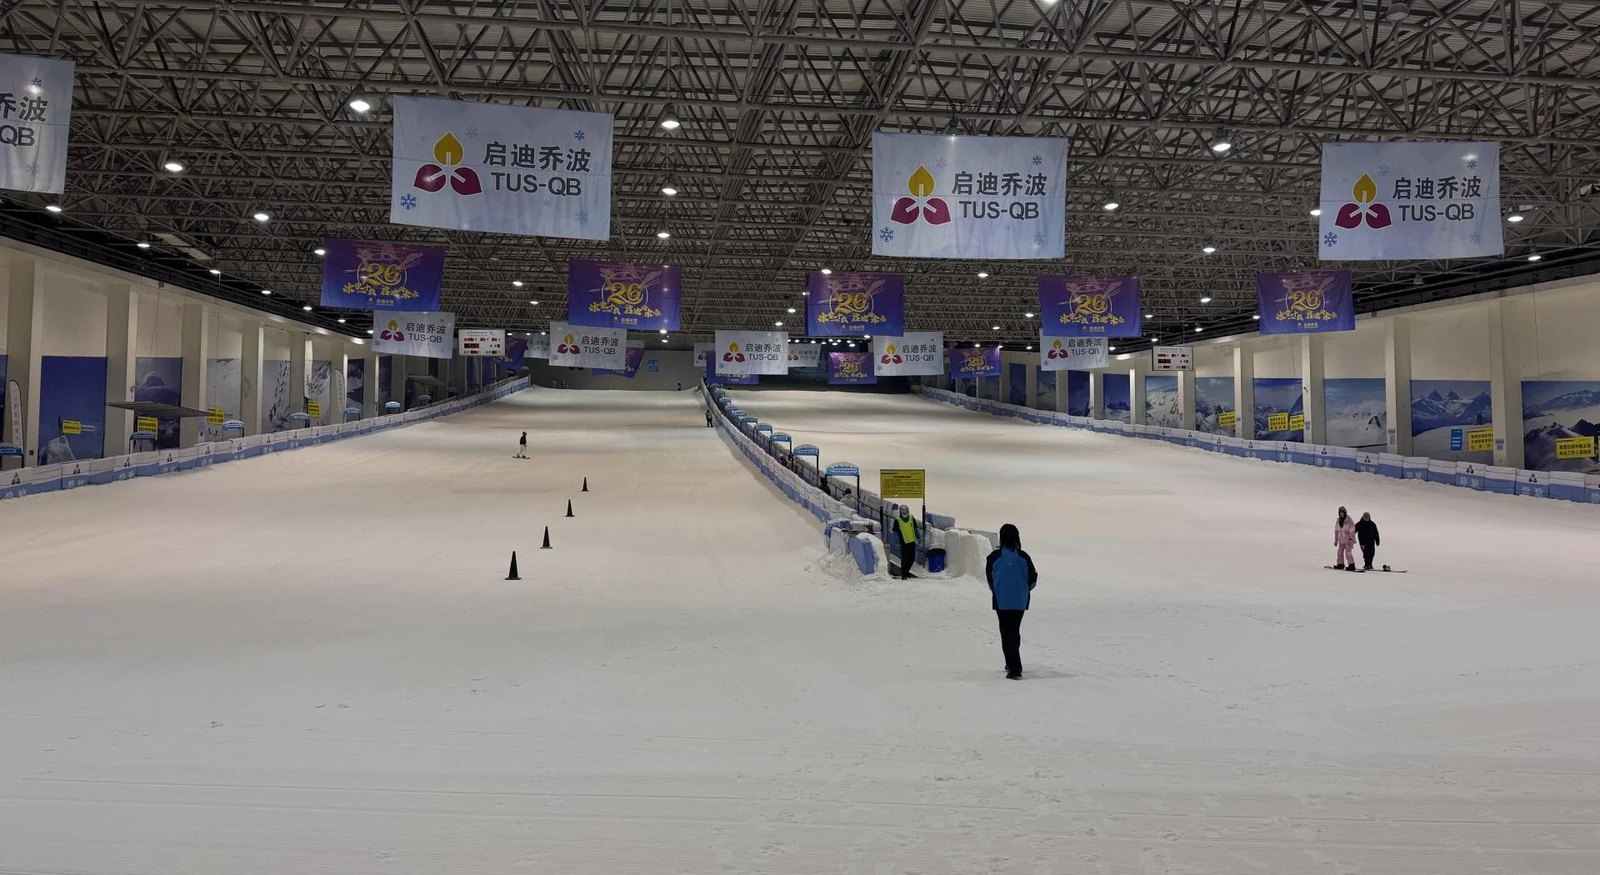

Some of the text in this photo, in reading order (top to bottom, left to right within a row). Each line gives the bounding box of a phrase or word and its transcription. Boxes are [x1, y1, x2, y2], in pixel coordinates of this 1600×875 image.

[0, 125, 35, 147] QB
[482, 141, 591, 173] 启迪乔波
[490, 172, 582, 197] TUS-QB
[951, 171, 1048, 196] 启迪乔波
[1392, 175, 1482, 200] 启迪乔波
[958, 200, 1040, 221] TUS-QB
[1398, 203, 1475, 222] TUS-QB
[363, 263, 401, 285] 20
[608, 282, 643, 304] 20
[835, 292, 869, 314] 20
[1290, 289, 1321, 311] 20
[1075, 293, 1108, 315] 20
[405, 322, 446, 335] 启迪乔波
[408, 332, 443, 343] TUS-QB
[581, 335, 620, 347] 启迪乔波
[583, 347, 616, 355] TUS-QB
[745, 343, 782, 352] 启迪乔波
[902, 344, 937, 353] 启迪乔波
[1068, 338, 1102, 348] 启迪乔波
[748, 353, 779, 361] TUS-QB
